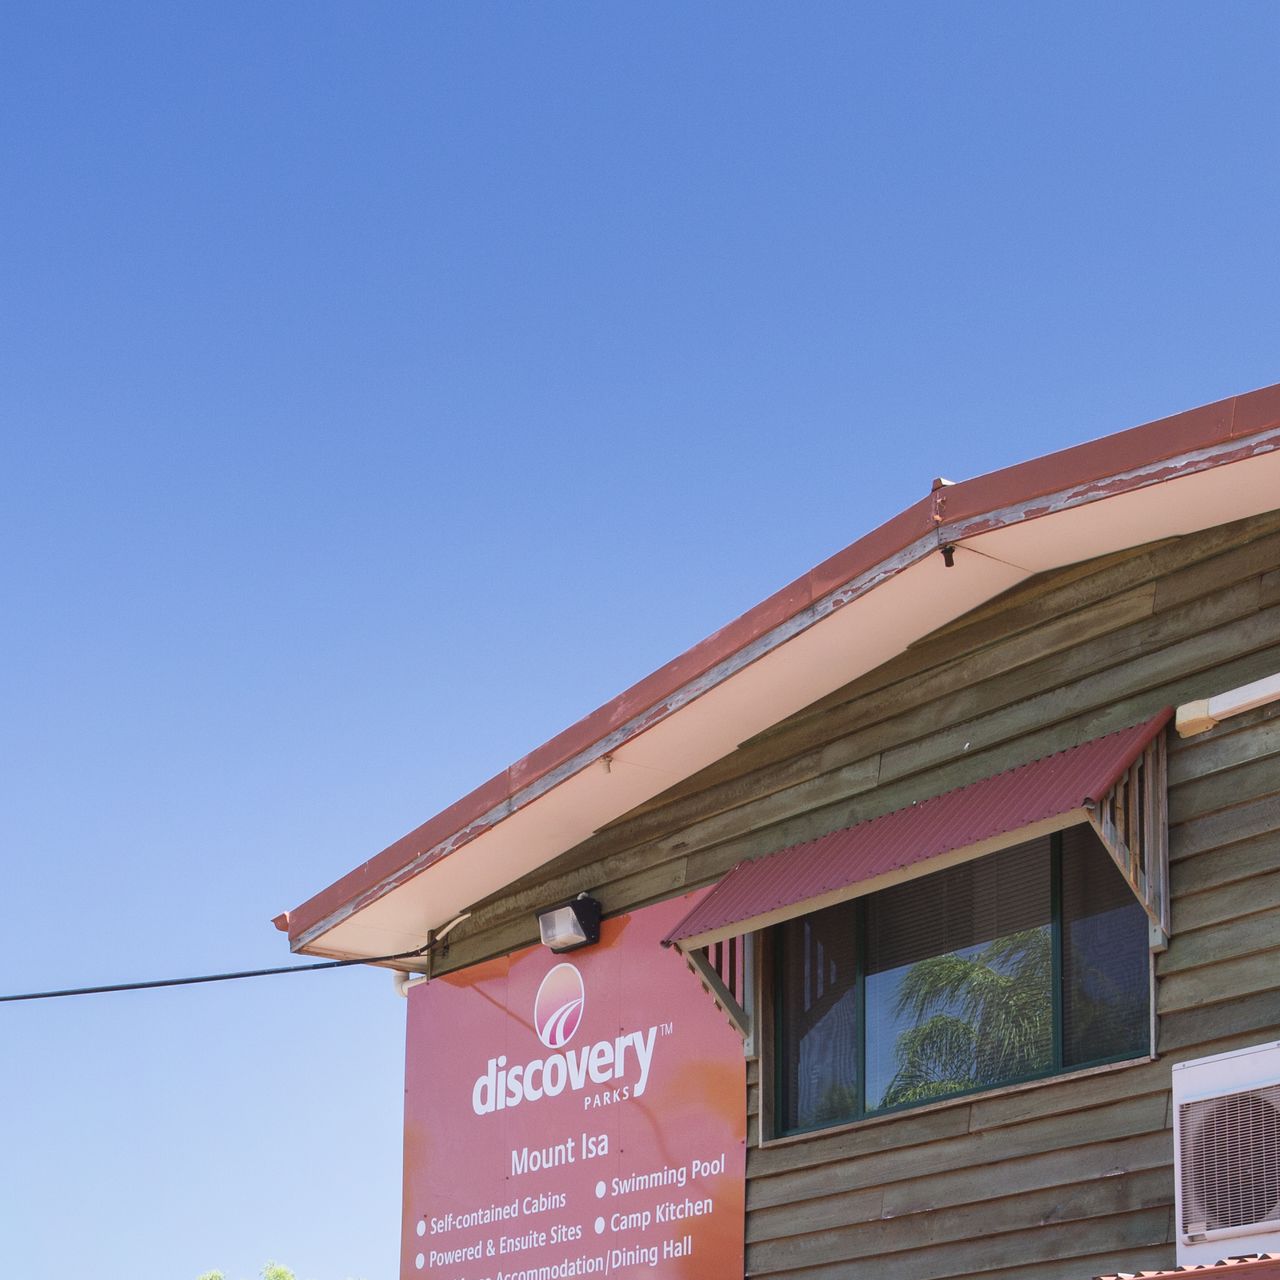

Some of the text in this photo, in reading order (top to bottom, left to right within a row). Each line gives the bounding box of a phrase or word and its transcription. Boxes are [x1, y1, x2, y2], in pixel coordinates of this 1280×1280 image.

[473, 1026, 657, 1115] discovery
[584, 1086, 630, 1110] PARKS
[511, 1133, 609, 1176] Mount Isa
[611, 1153, 725, 1196] Swimming Pool
[430, 1192, 567, 1235] Self-contained Cabins
[610, 1198, 713, 1232] Camp Kitchen
[429, 1224, 583, 1268] Powered & Ensuite Sites
[663, 1235, 692, 1259] Hall
